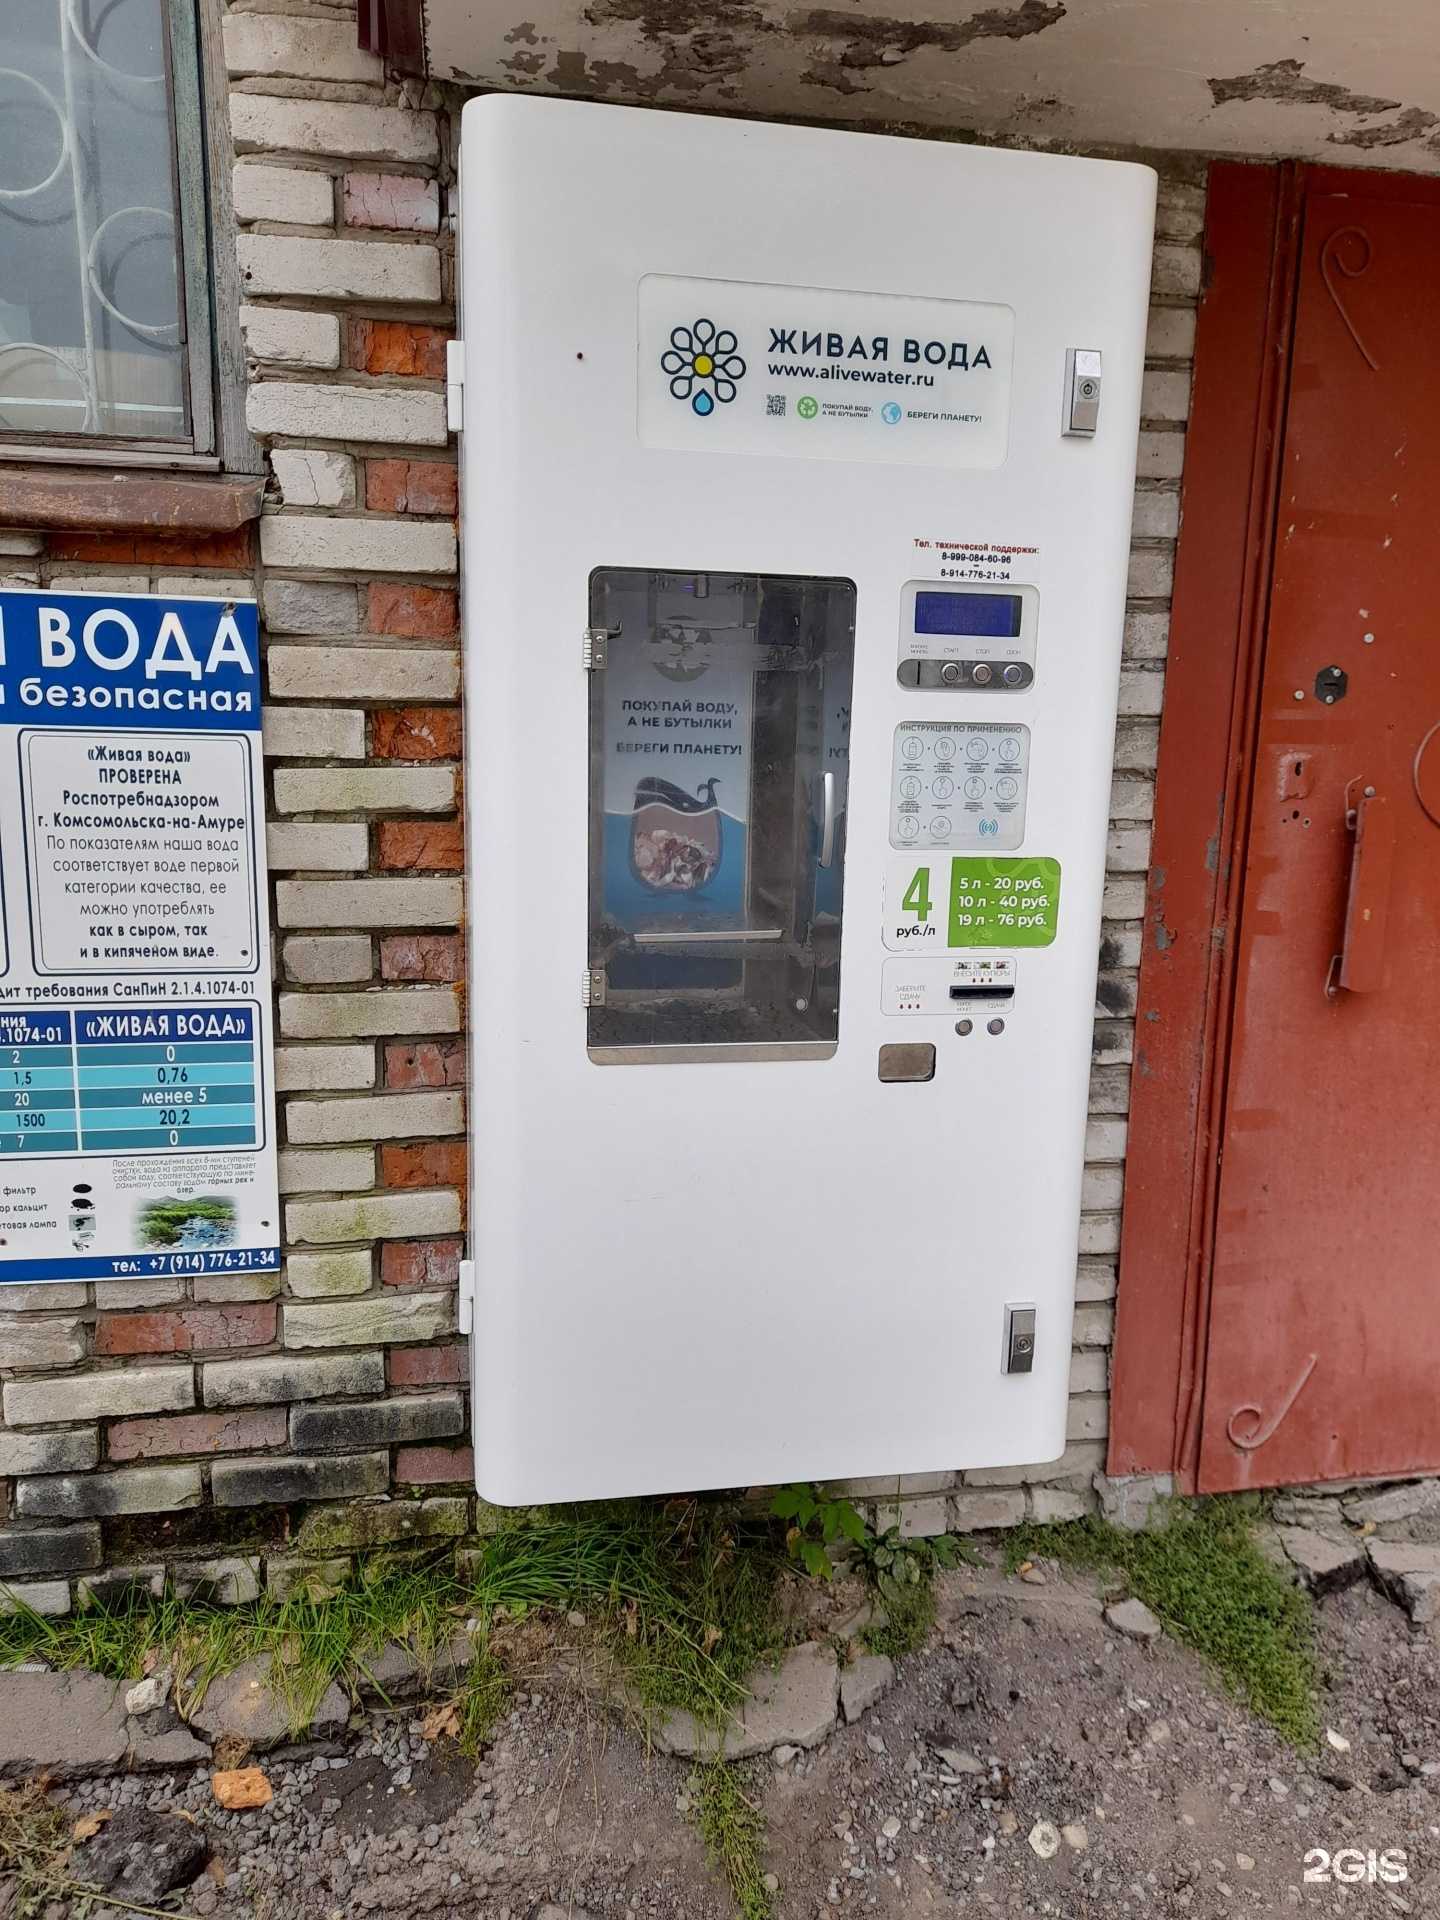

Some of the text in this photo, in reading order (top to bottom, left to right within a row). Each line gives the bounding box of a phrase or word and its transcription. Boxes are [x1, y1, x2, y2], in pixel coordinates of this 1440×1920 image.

[768, 328, 992, 371] ЖИВАЯ ВОДА
[768, 364, 934, 387] www.alivewater.ru
[907, 411, 983, 423] БЕРЕГИ ПЛАНЕТУ!
[914, 539, 1040, 554] Тел. технической поддержки:
[941, 569, 1010, 580] 8-914-776-21-34
[38, 606, 254, 681] ВОДА
[19, 677, 252, 712] безопасная
[622, 700, 738, 715] ПОКУПАЙ ВОДУ,
[627, 717, 732, 729] А НЕ БУТЫЛКИ
[900, 724, 951, 733] ИНСТРУКЦИЯ
[953, 725, 966, 733] ПО
[88, 745, 191, 764] «Живая вода»
[616, 742, 742, 755] БЕРЕГИ ПЛАНЕТУ!
[98, 768, 182, 785] ПРОВЕРЕНА
[63, 790, 219, 808] Роспотребнадзором
[38, 811, 245, 832] г. Комсомольска-на-Амуре
[47, 836, 239, 853] По показателям наша вода
[52, 857, 240, 877] соответствует воде первой
[64, 882, 226, 898] категории качества, ее
[959, 878, 968, 889] 5
[972, 880, 981, 889] л
[994, 878, 1010, 889] 20
[1015, 877, 1044, 892] руб.
[902, 868, 932, 922] 4
[959, 896, 973, 907] 10
[976, 897, 987, 907] л
[999, 896, 1018, 907] 40
[1021, 895, 1050, 909] руб.
[80, 902, 215, 920] можно употреблять
[958, 914, 972, 925] 19
[975, 915, 985, 925] л
[997, 914, 1014, 925] 76
[1017, 913, 1047, 927] руб.
[89, 925, 208, 941] как в сыром, так
[896, 924, 936, 938] руб./л
[80, 946, 219, 960] и в кипяченом виде.
[26, 983, 108, 1000] требования
[113, 981, 166, 997] СанПиН
[171, 981, 255, 996] 2.1.4.1074-01
[86, 1013, 245, 1038] «ЖИВАЯ ВОДА»
[12, 1050, 20, 1064] 2
[166, 1046, 175, 1062] 0
[14, 1071, 32, 1085] 1,5
[157, 1067, 188, 1084] 0,76
[14, 1093, 30, 1106] 20
[142, 1088, 207, 1105] менее 5
[16, 1113, 45, 1127] 1500
[159, 1109, 191, 1126] 20,2
[17, 1135, 25, 1148] 7
[169, 1131, 179, 1146] 0
[3, 1186, 36, 1196] фильтр
[13, 1203, 48, 1213] кальцит
[0, 1221, 57, 1230] товая лампа
[112, 1251, 275, 1273] тел: +7 (914) 776-21-34
